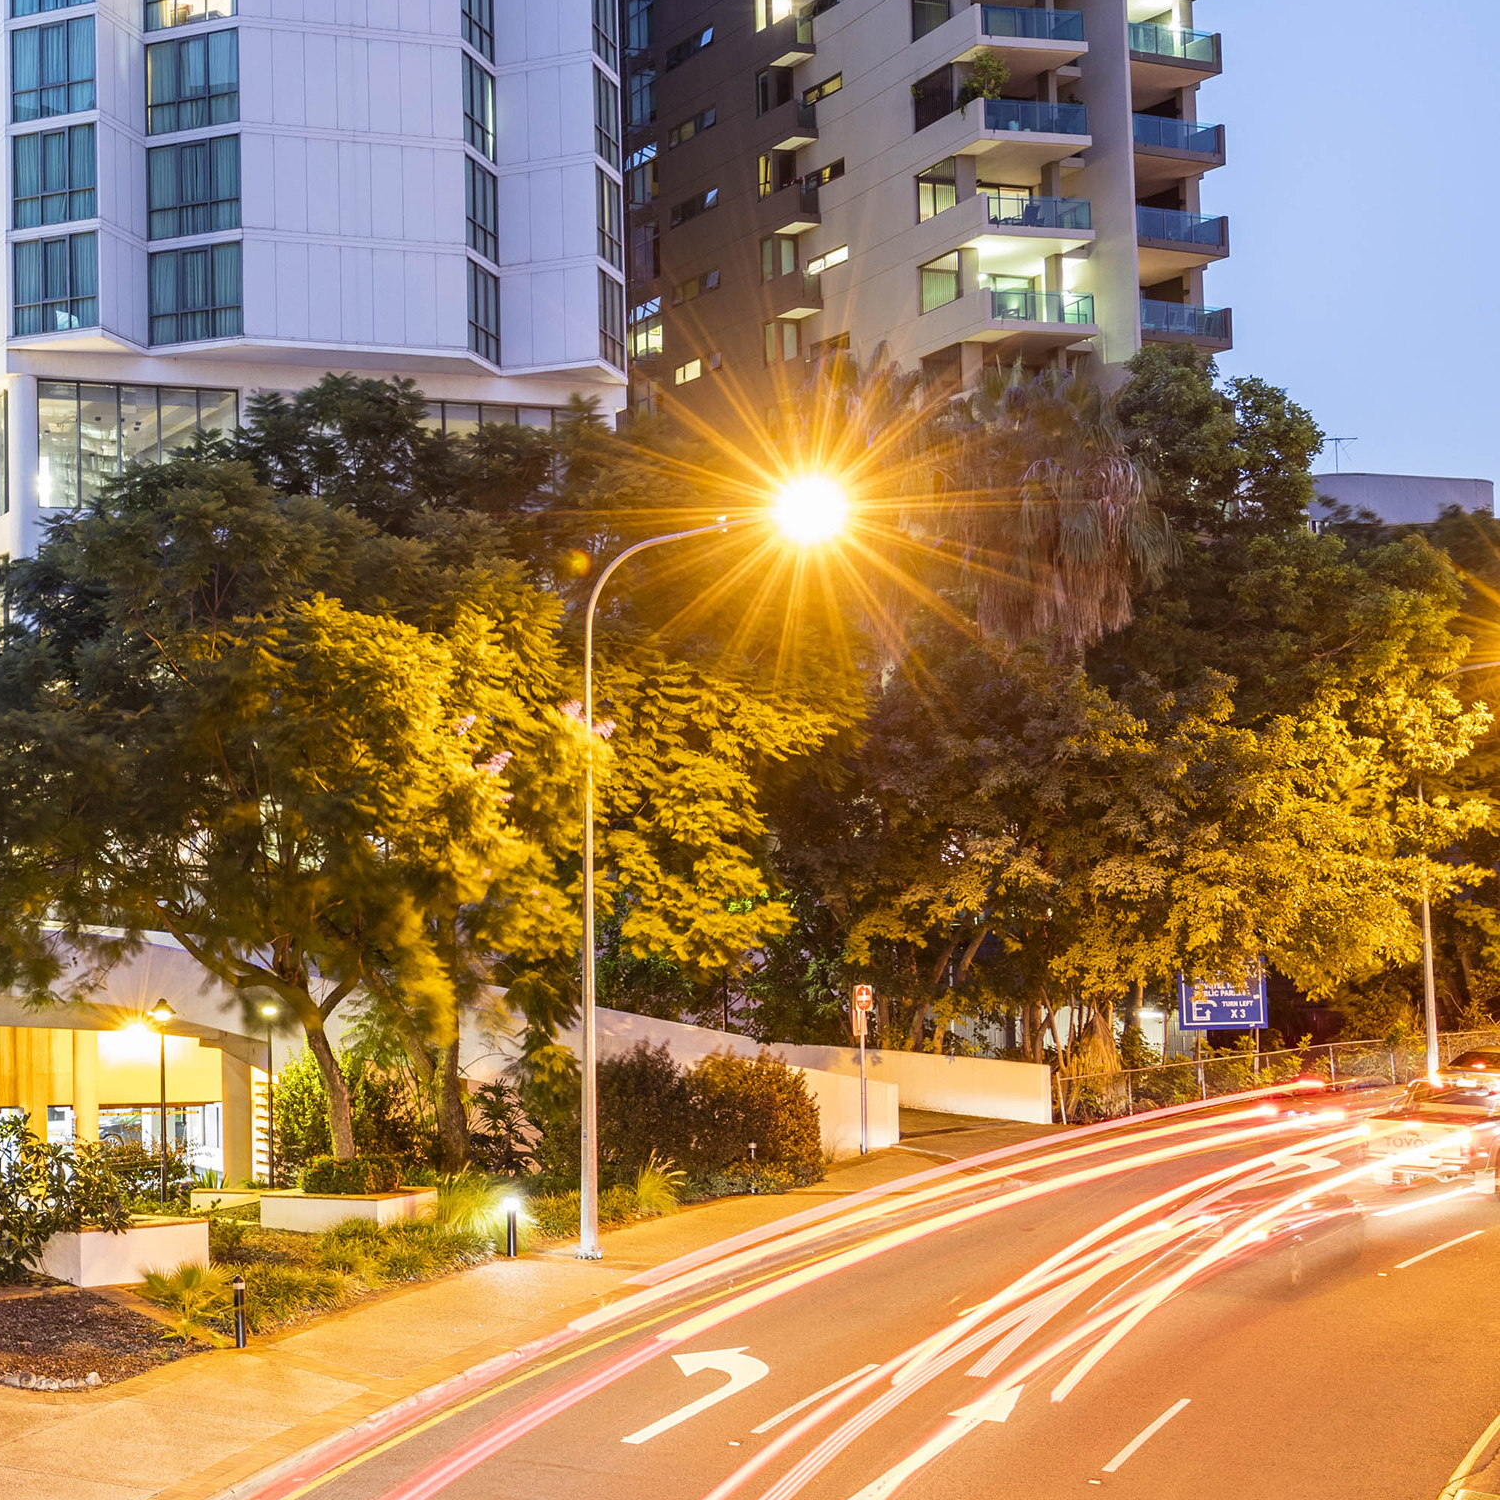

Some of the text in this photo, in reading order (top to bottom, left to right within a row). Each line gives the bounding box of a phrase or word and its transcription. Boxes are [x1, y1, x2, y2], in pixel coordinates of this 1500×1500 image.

[1230, 1009, 1246, 1018] X 3
[1383, 1135, 1432, 1149] TOYO
